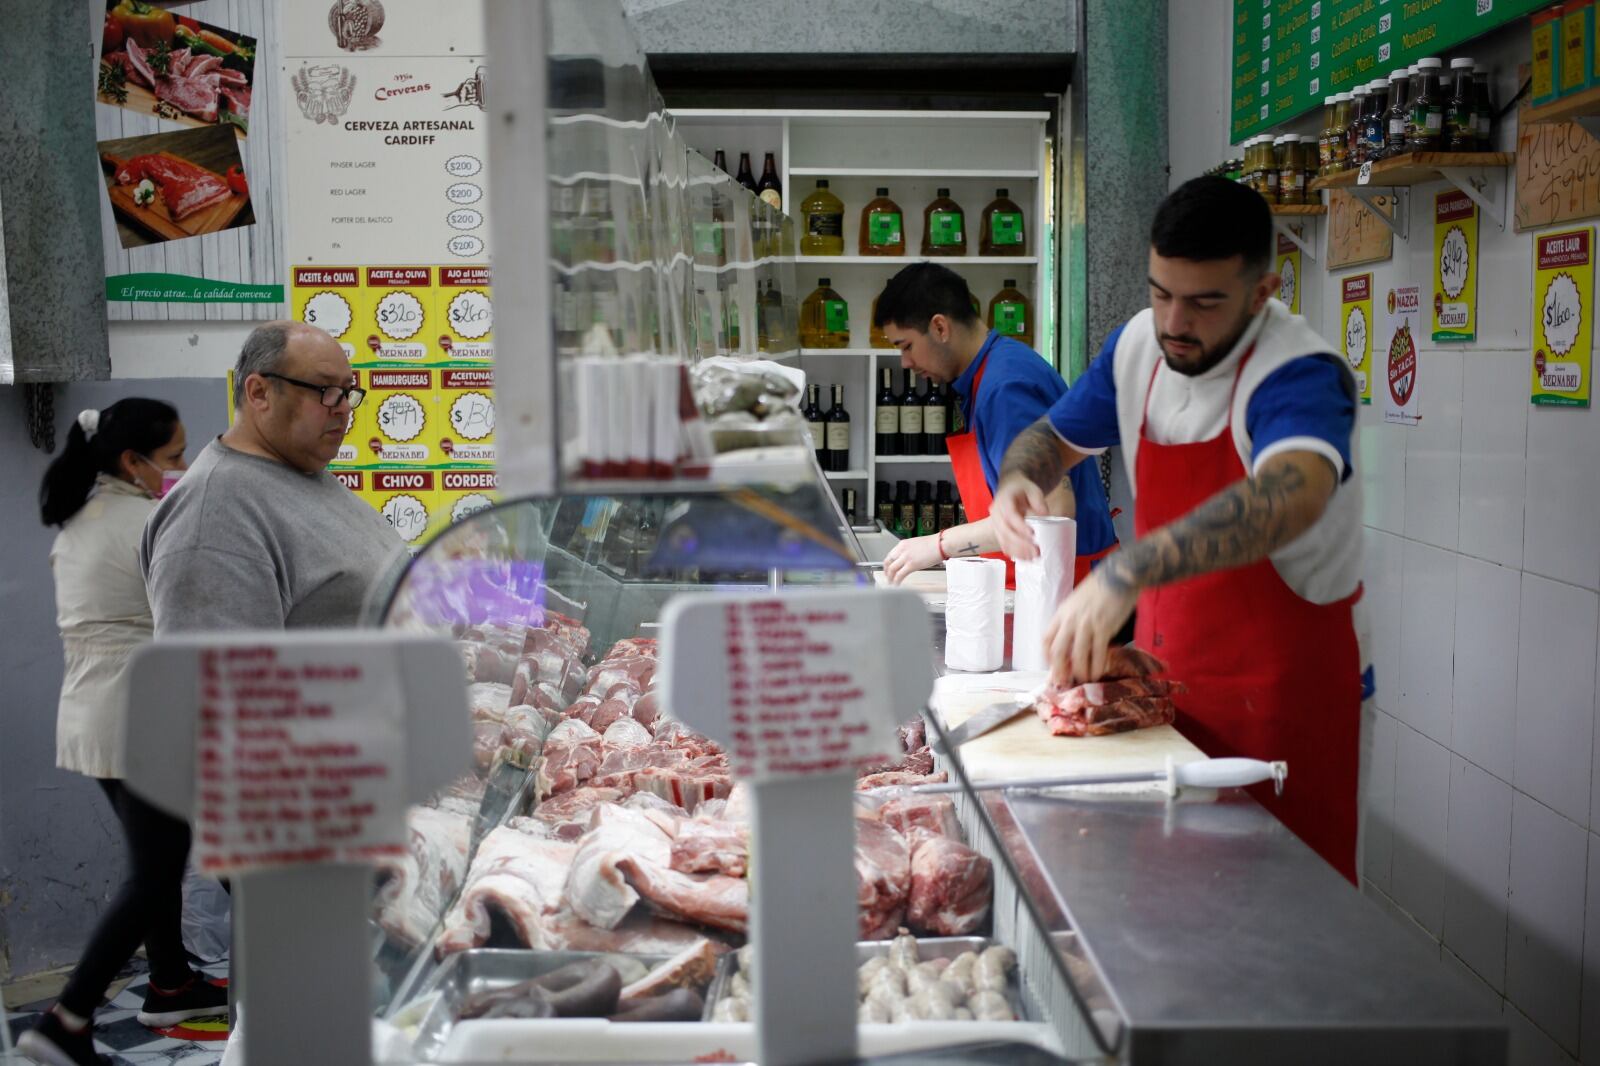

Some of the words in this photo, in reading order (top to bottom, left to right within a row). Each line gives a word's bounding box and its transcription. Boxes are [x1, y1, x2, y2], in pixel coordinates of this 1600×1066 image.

[374, 83, 430, 100] Cervezas
[344, 121, 398, 130] CERVEZA
[403, 120, 474, 130] ARTESANAL
[384, 136, 436, 145] CARDIFF
[450, 162, 472, 171] $200
[450, 189, 472, 198] $200
[451, 215, 474, 224] $200
[452, 240, 474, 250] $200
[1546, 240, 1564, 254] ACEITE
[1566, 238, 1580, 252] LAUR
[298, 272, 321, 282] ACEITE
[323, 272, 332, 282] de
[333, 272, 355, 282] OLIVA
[121, 286, 133, 297] El
[135, 288, 162, 300] precio
[204, 288, 233, 298] calidad
[236, 290, 272, 299] convence
[1397, 295, 1418, 308] NAZCA
[308, 310, 316, 322] $
[1440, 313, 1466, 325] BERNABEI
[373, 375, 428, 386] HAMBURGUESAS
[1543, 374, 1577, 388] BERNABEI
[382, 475, 424, 487] CHIVO
